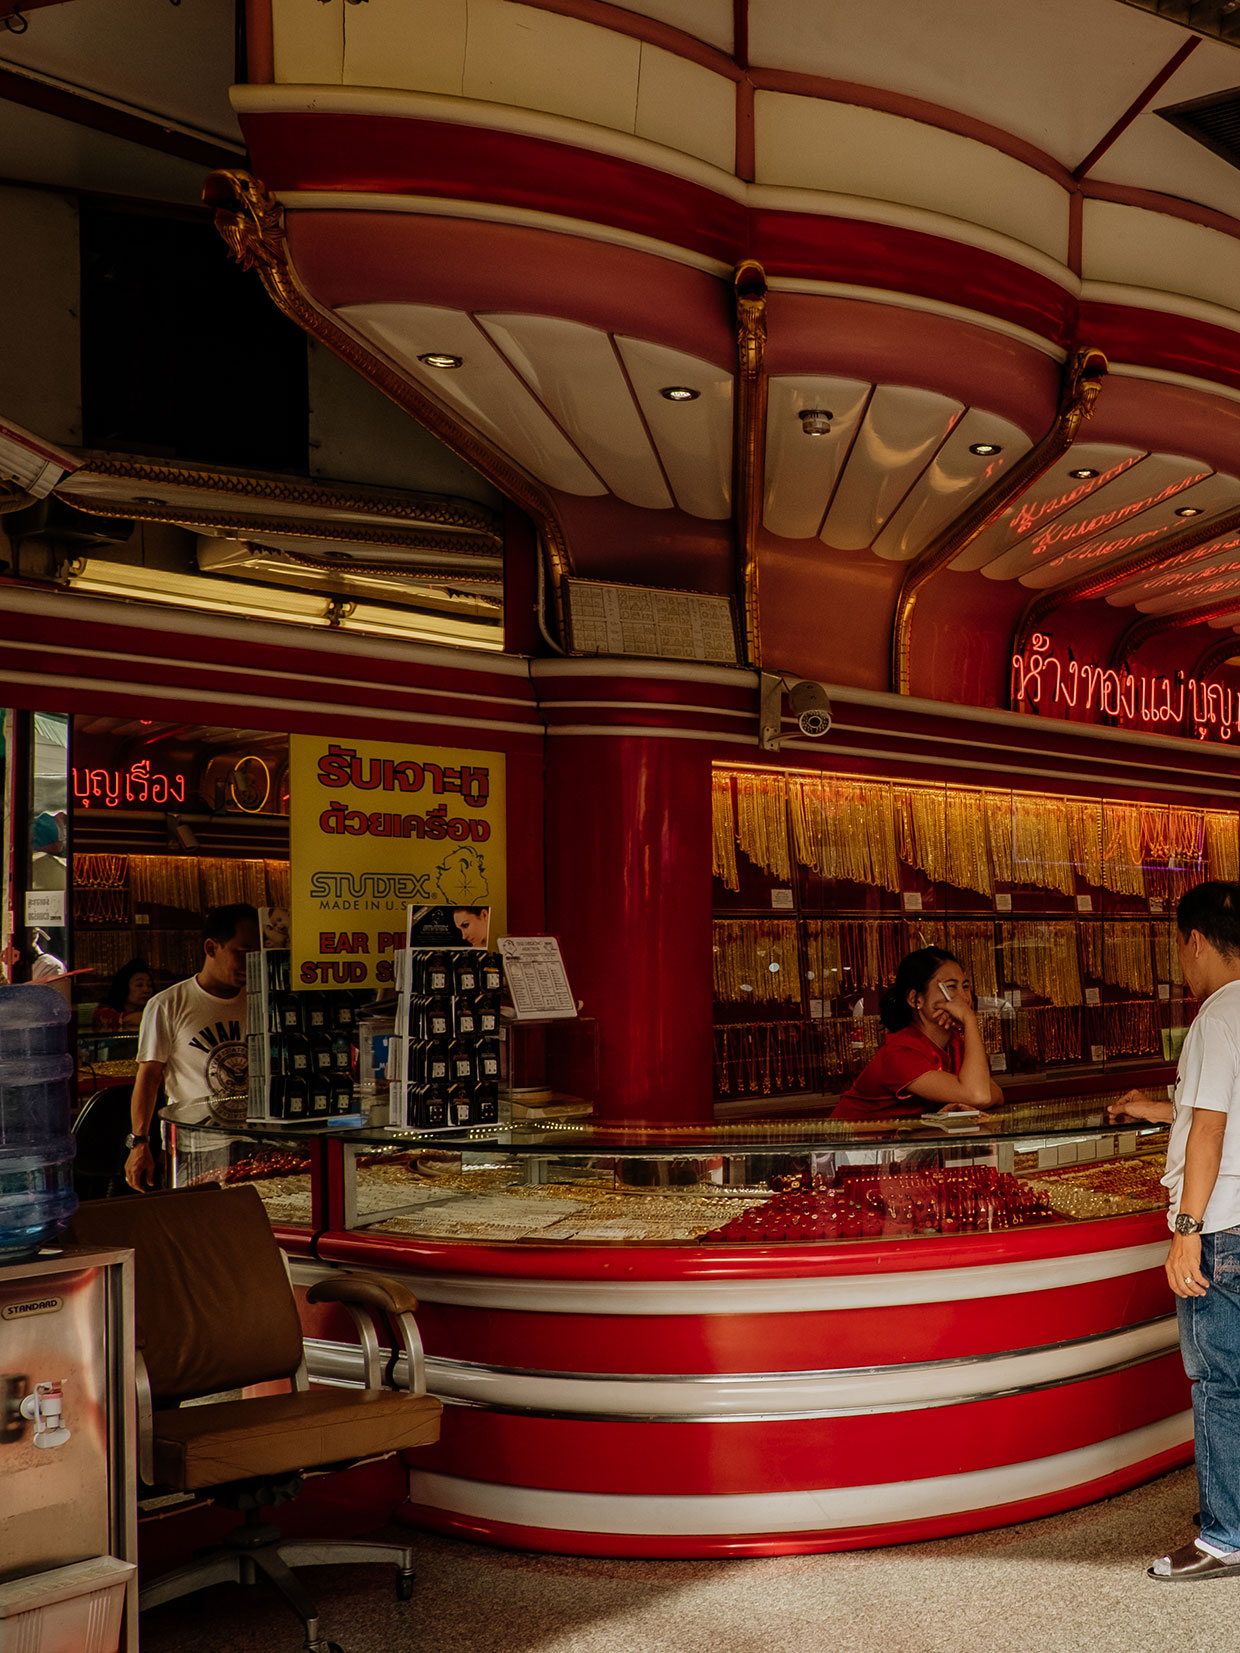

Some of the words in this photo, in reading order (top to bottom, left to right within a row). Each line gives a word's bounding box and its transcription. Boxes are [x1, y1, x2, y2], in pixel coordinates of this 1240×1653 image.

[72, 760, 186, 809] บุญเรือง
[317, 744, 490, 807] รับเจาะหู
[319, 801, 491, 843] ด้วยเครื่อง
[310, 871, 431, 899] STUDEX
[319, 900, 360, 910] MADE
[365, 900, 380, 910] IN
[319, 932, 370, 954] EAR
[300, 961, 367, 984] STUD
[7, 1299, 57, 1315] STANDARD
